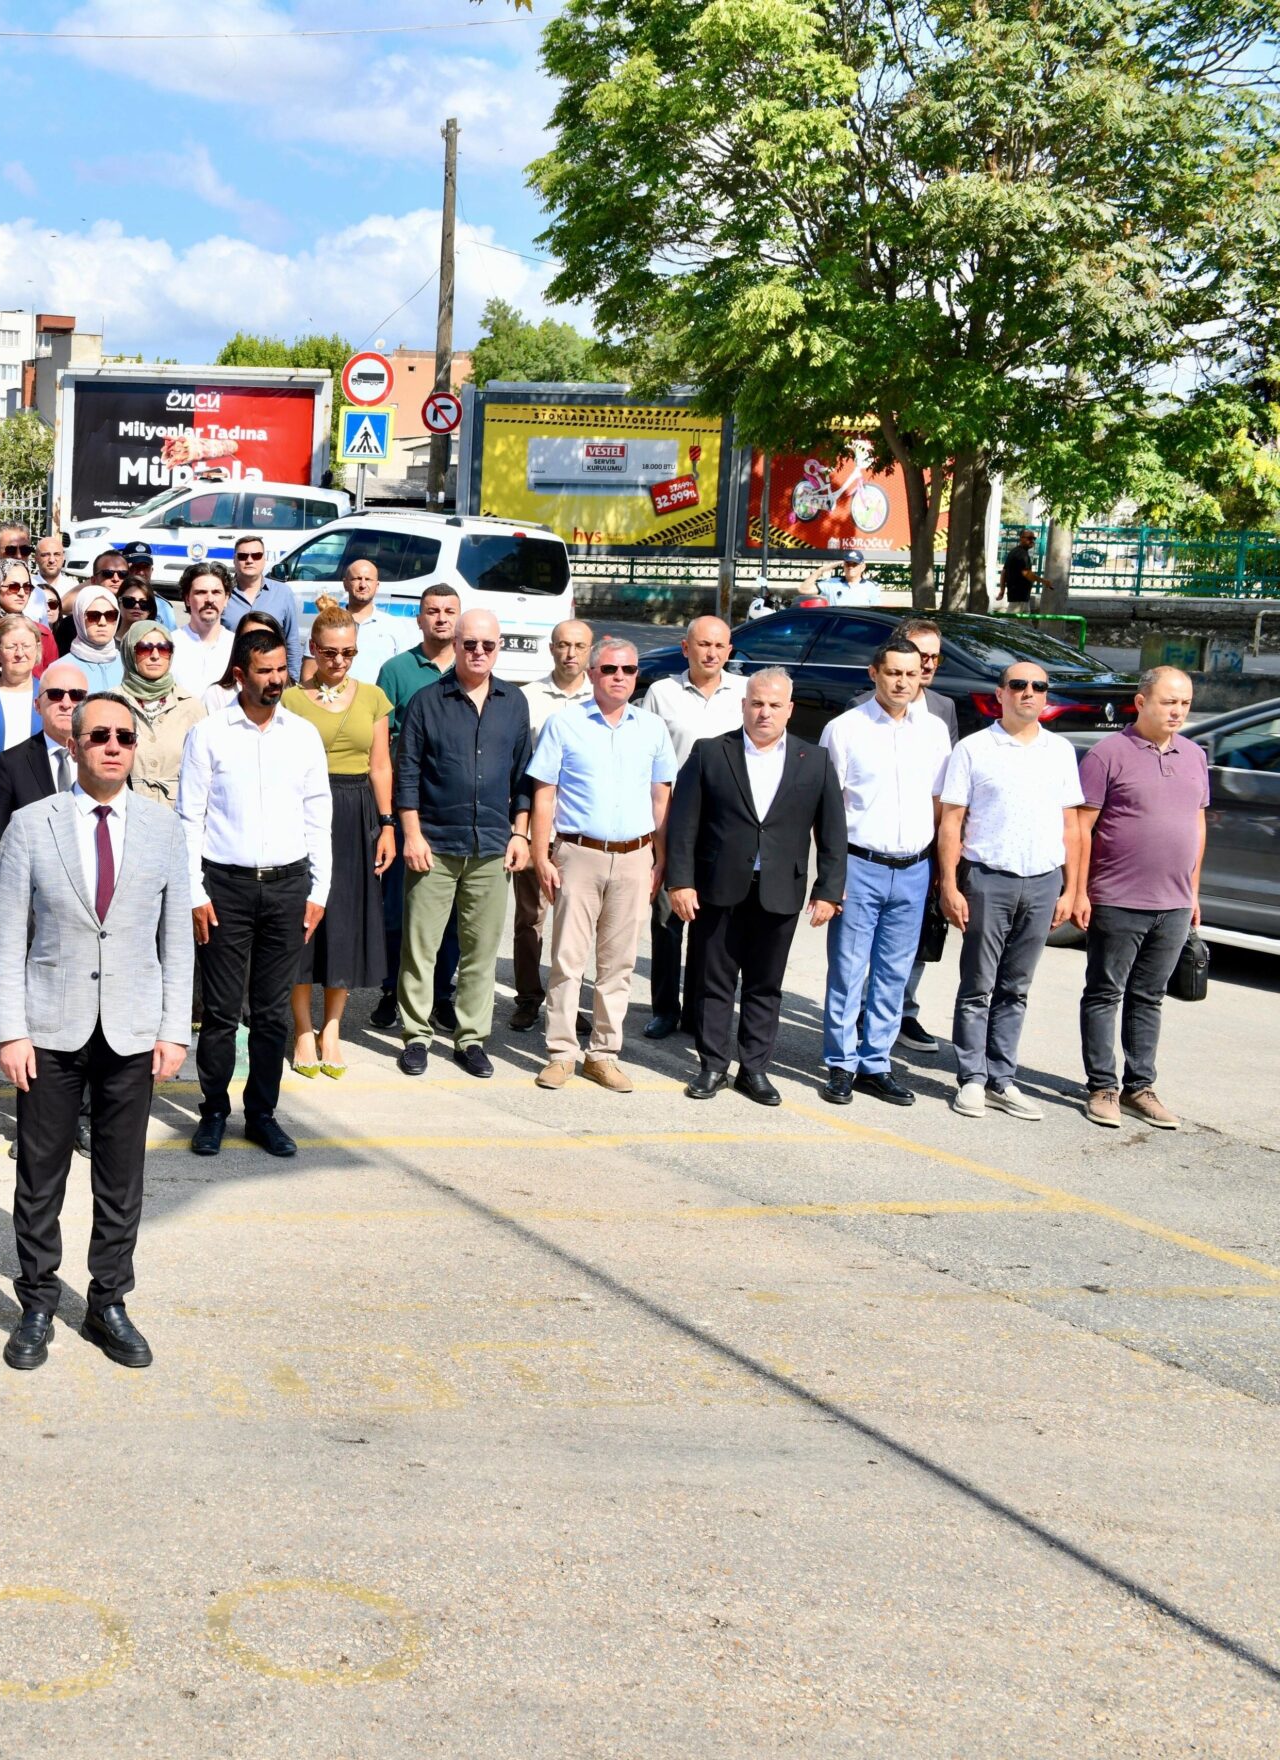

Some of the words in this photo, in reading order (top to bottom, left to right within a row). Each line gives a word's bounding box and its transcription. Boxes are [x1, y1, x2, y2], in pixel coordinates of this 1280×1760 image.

[534, 412, 590, 422] STOKLARI
[118, 420, 204, 440] Milyonlar
[207, 424, 268, 441] Tadına
[588, 446, 622, 456] VESTEL
[573, 527, 602, 545] hys
[509, 639, 519, 648] SK
